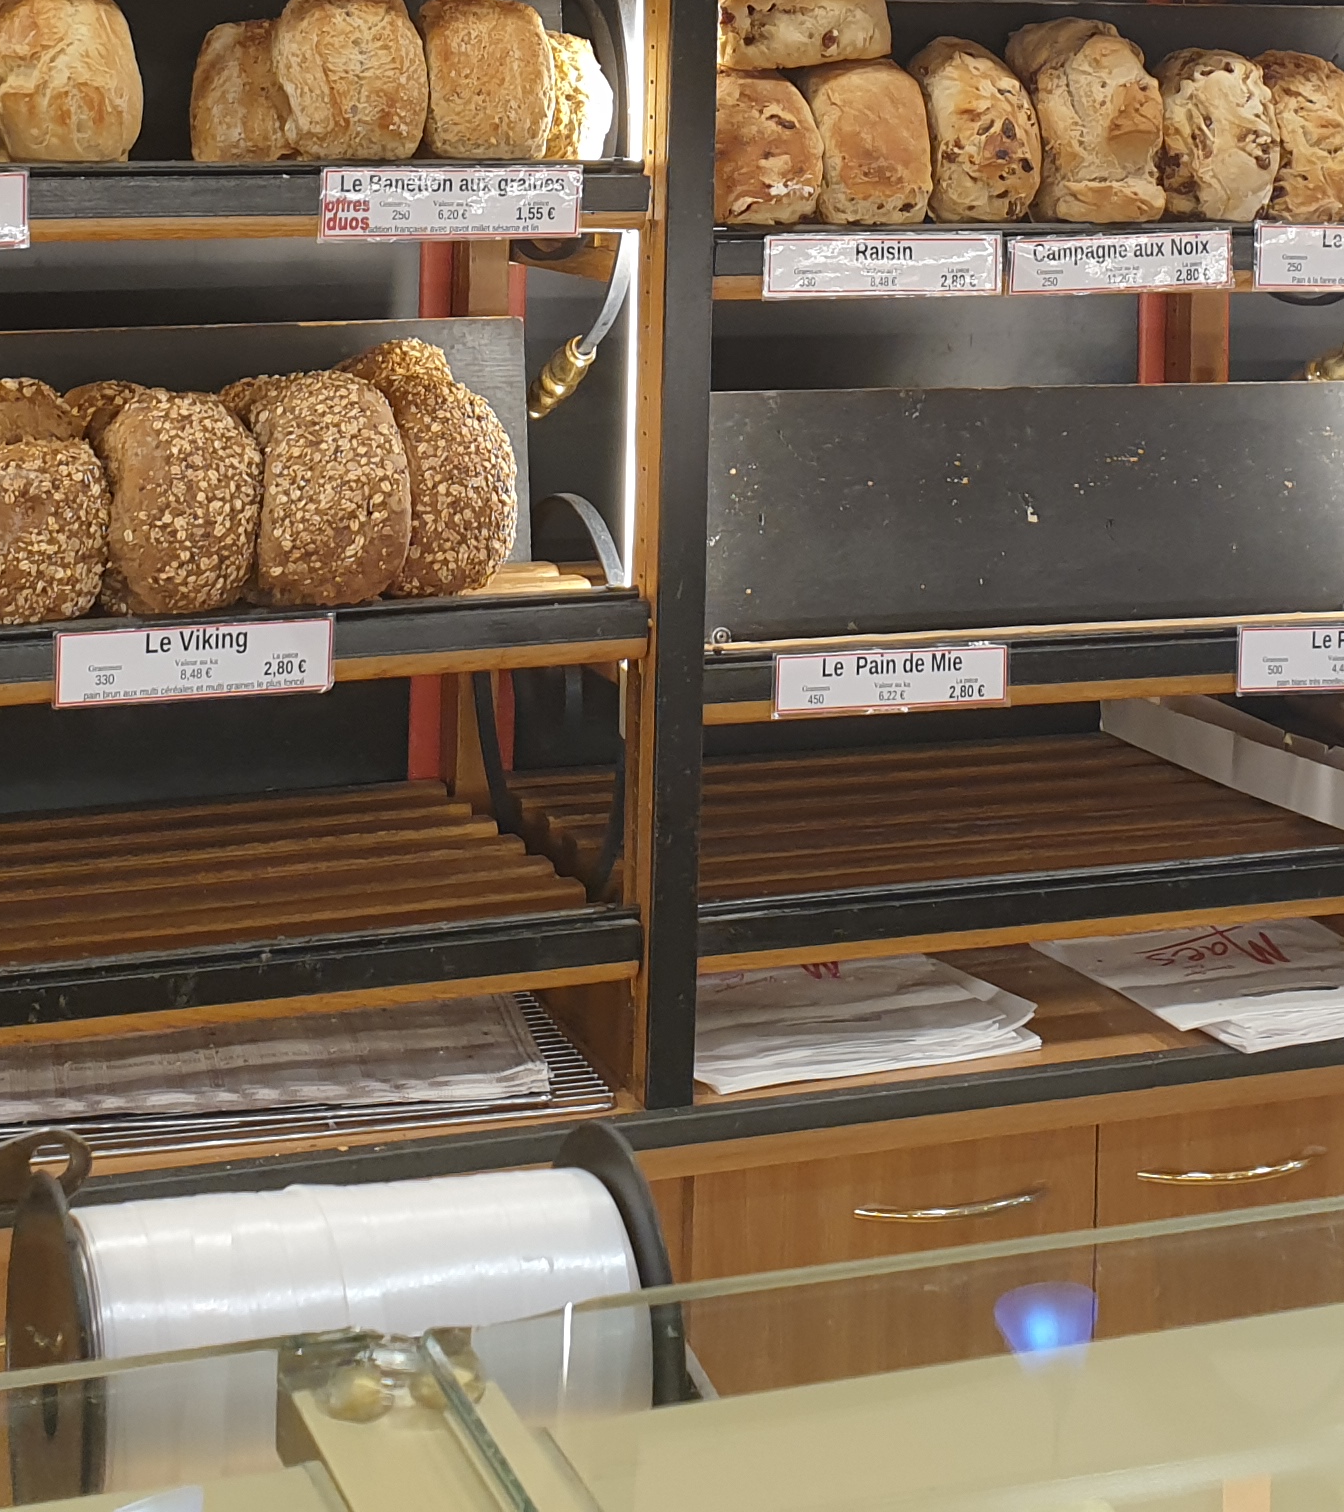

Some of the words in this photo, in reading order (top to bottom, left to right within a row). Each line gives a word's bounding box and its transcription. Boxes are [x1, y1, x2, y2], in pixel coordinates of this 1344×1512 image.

[340, 175, 362, 193] Le
[438, 210, 459, 221] 6,20
[516, 207, 544, 221] 1,55
[547, 207, 556, 220] €
[326, 214, 370, 231] duos
[856, 241, 913, 261] Raisin
[1133, 242, 1165, 257] aux
[1171, 235, 1210, 255] Noix
[1287, 263, 1302, 272] 250
[1042, 277, 1058, 287] 250
[1176, 269, 1200, 284] 2,80
[146, 632, 172, 654] Le
[180, 628, 248, 653] Viking
[1312, 631, 1332, 649] Le
[264, 660, 294, 676] 2,80
[298, 659, 306, 673] €
[822, 658, 844, 677] Le
[856, 654, 896, 676] Pain
[903, 657, 925, 673] de
[931, 651, 963, 672] Mie
[1268, 665, 1283, 675] 500
[95, 674, 115, 685] 330
[808, 694, 824, 704] 450
[949, 685, 974, 700] 2,80
[977, 685, 985, 697] €
